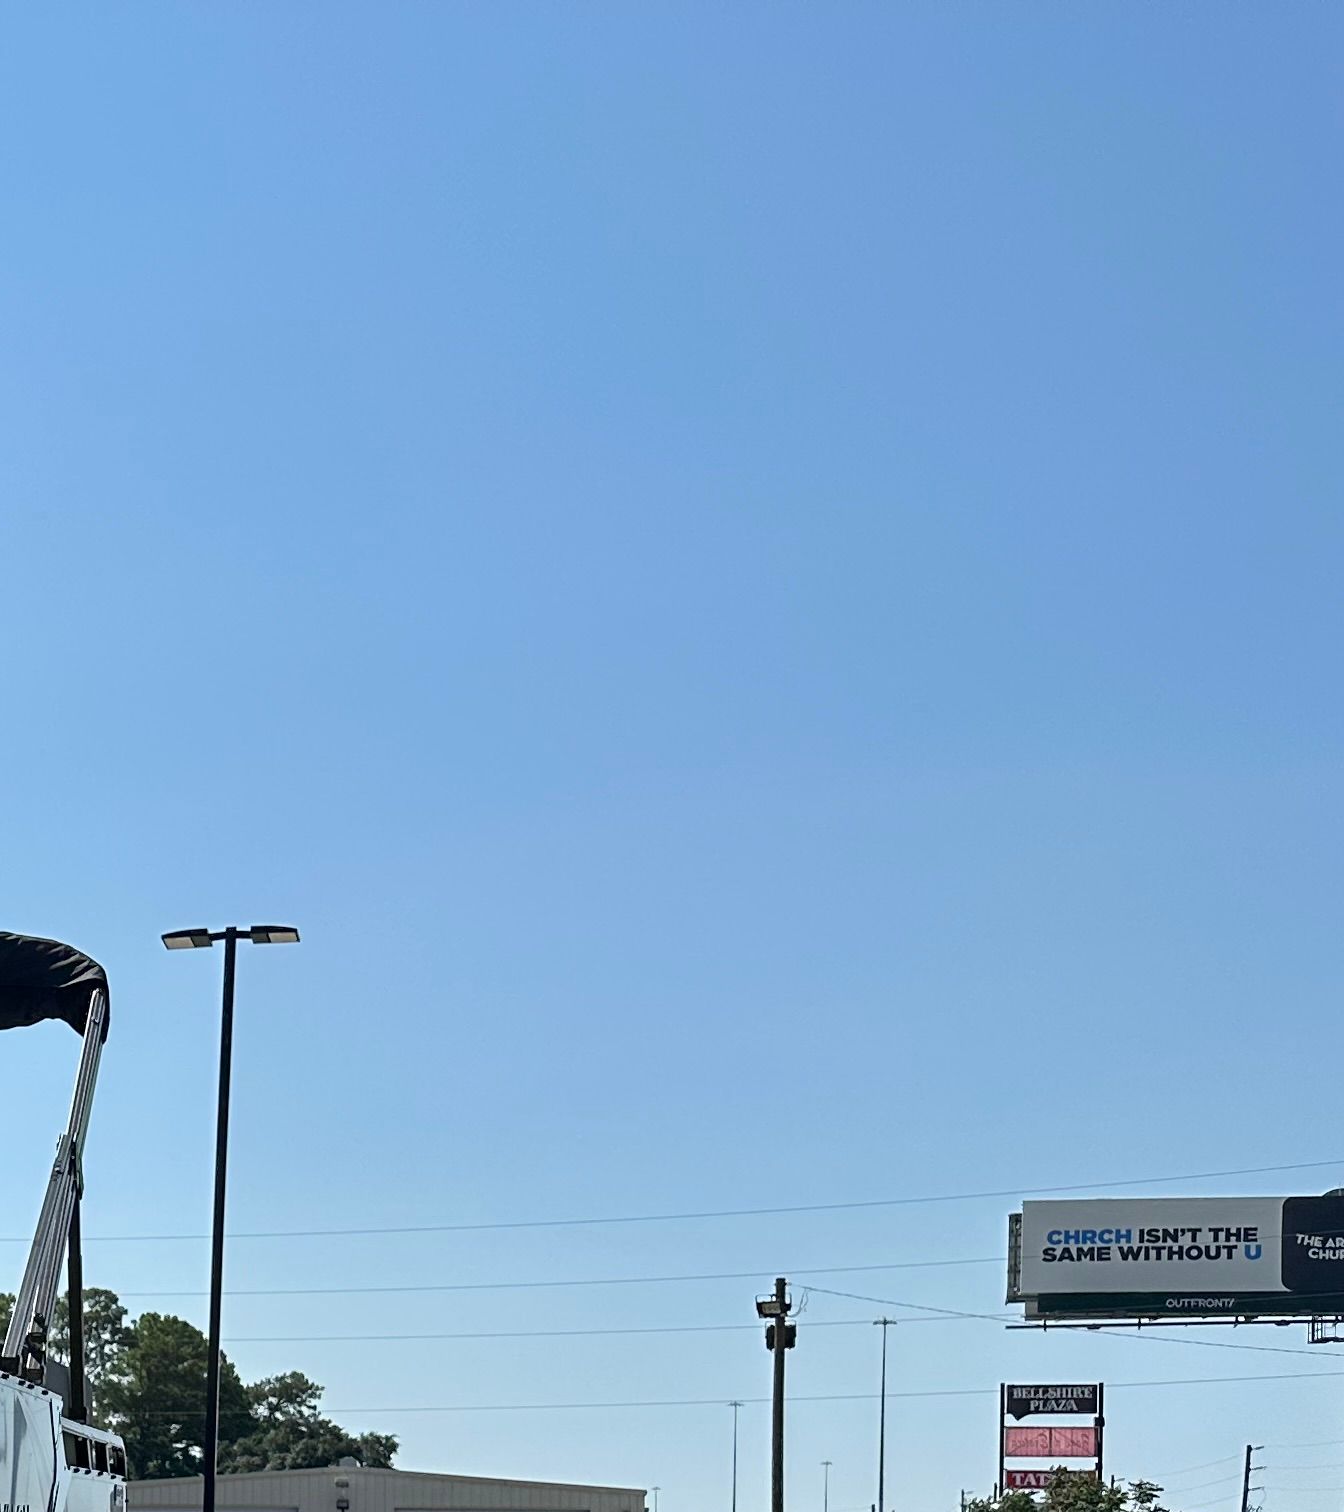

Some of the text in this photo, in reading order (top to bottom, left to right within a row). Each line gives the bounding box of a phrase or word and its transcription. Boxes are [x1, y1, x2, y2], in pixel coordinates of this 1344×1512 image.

[1047, 1229, 1132, 1245] CHRCH
[1208, 1227, 1258, 1243] THE
[1296, 1233, 1323, 1247] THE
[1042, 1244, 1262, 1263] SAME WITHOUT U
[1012, 1386, 1094, 1399] BELLSHIRE
[1029, 1399, 1079, 1412] PLAZA
